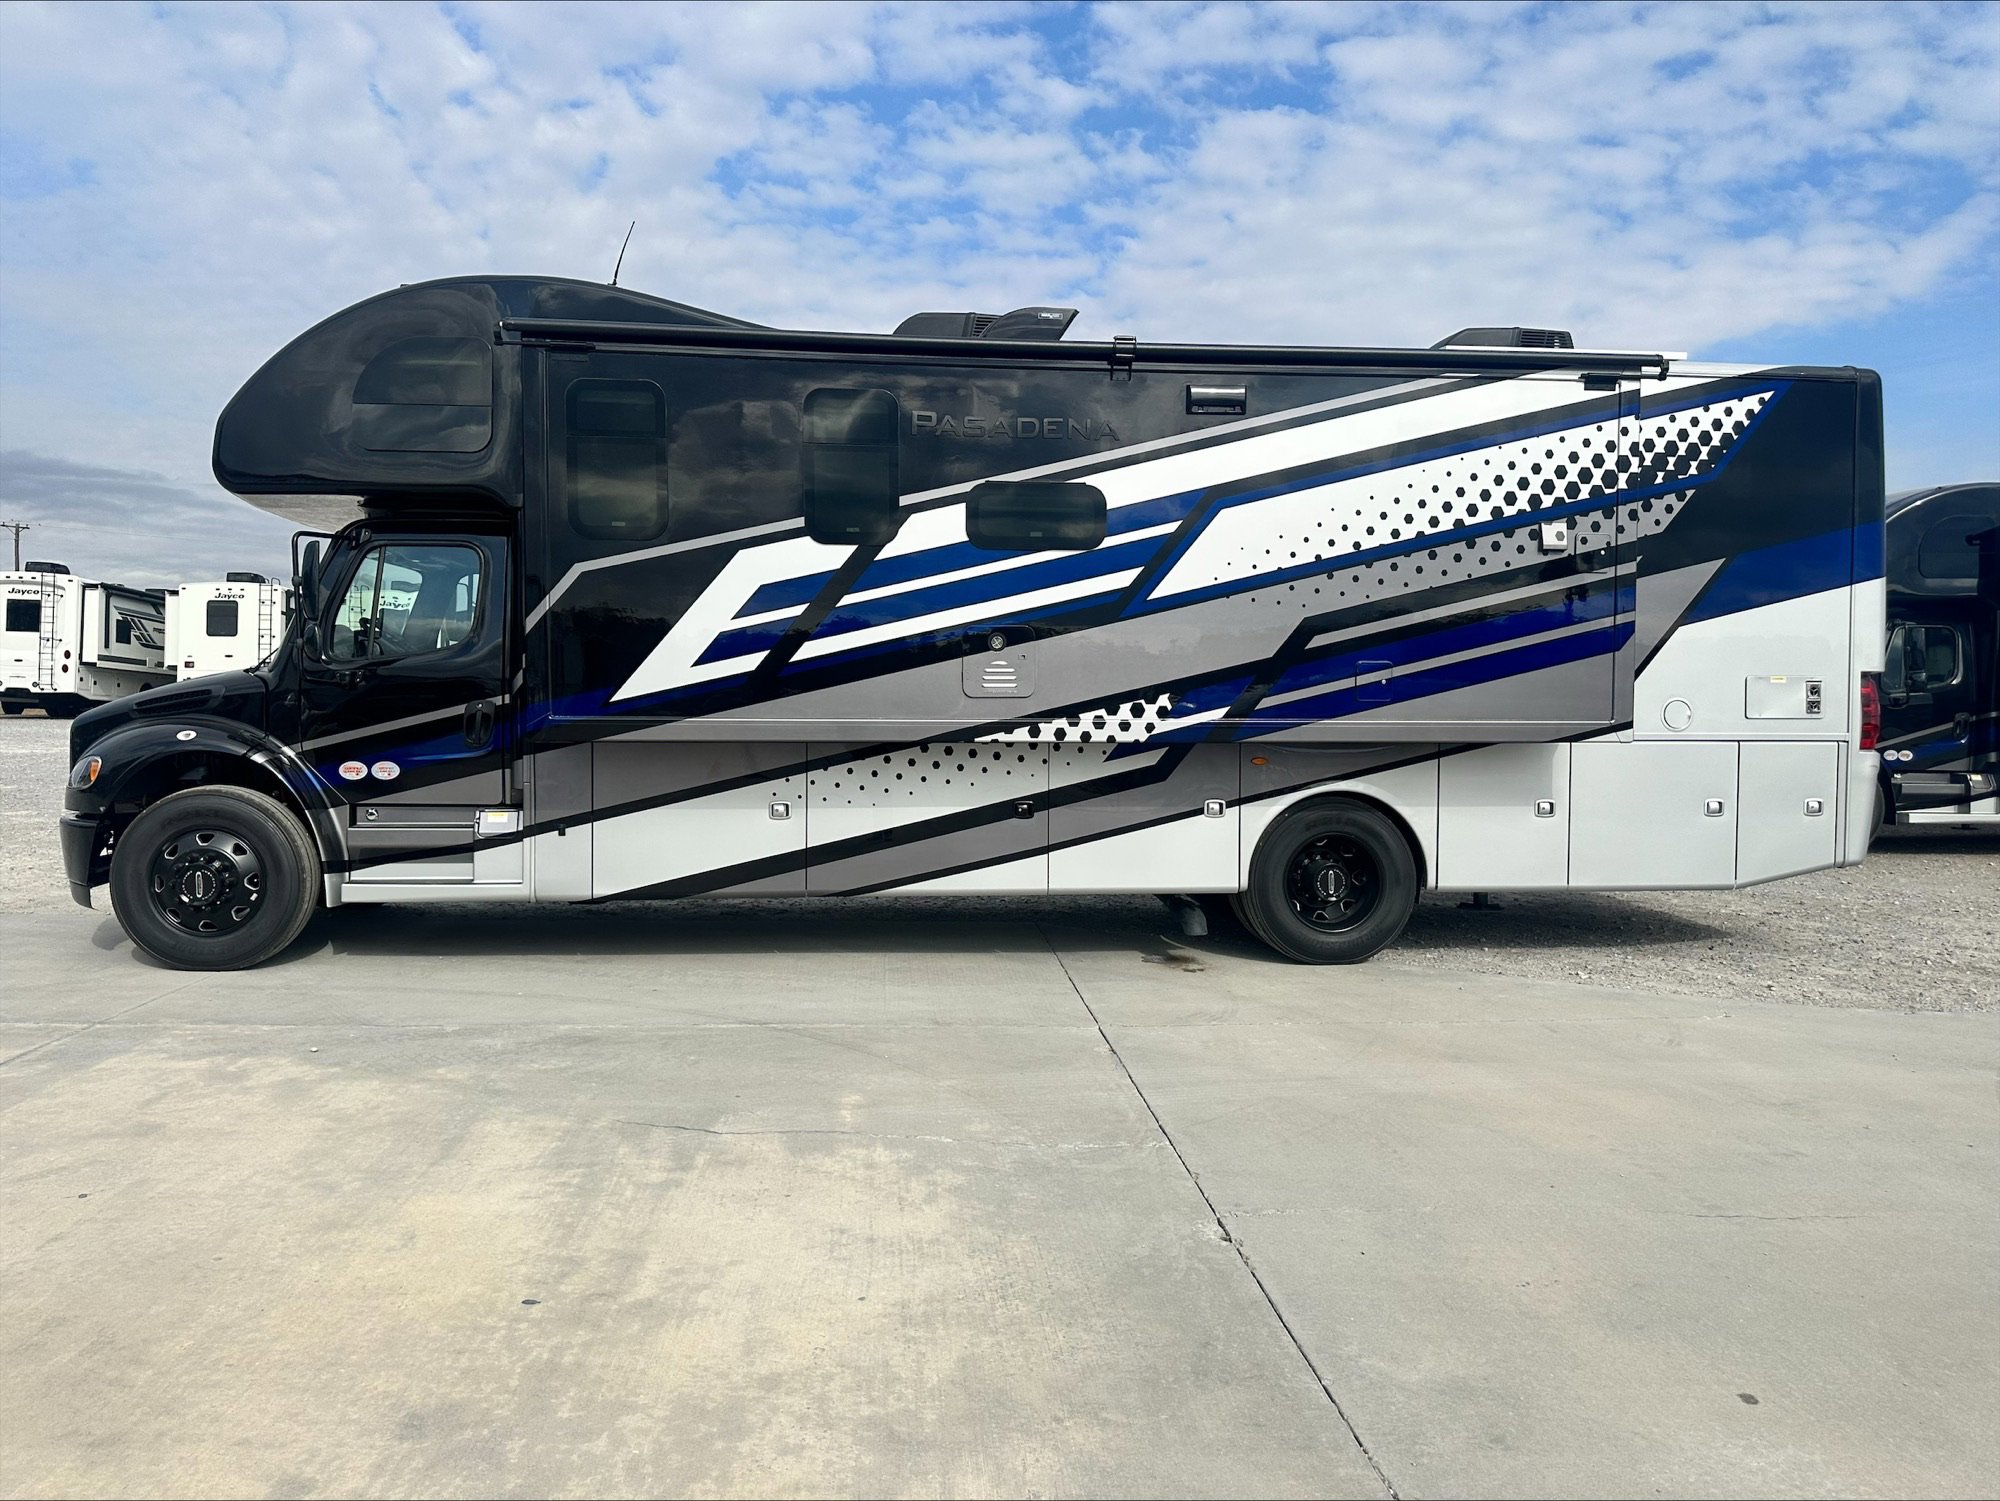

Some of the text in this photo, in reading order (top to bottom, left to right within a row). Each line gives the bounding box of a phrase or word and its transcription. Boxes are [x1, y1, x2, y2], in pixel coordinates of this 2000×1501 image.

[912, 410, 1120, 441] PASADENA
[8, 587, 40, 596] Jayco
[214, 592, 245, 600] Jayco
